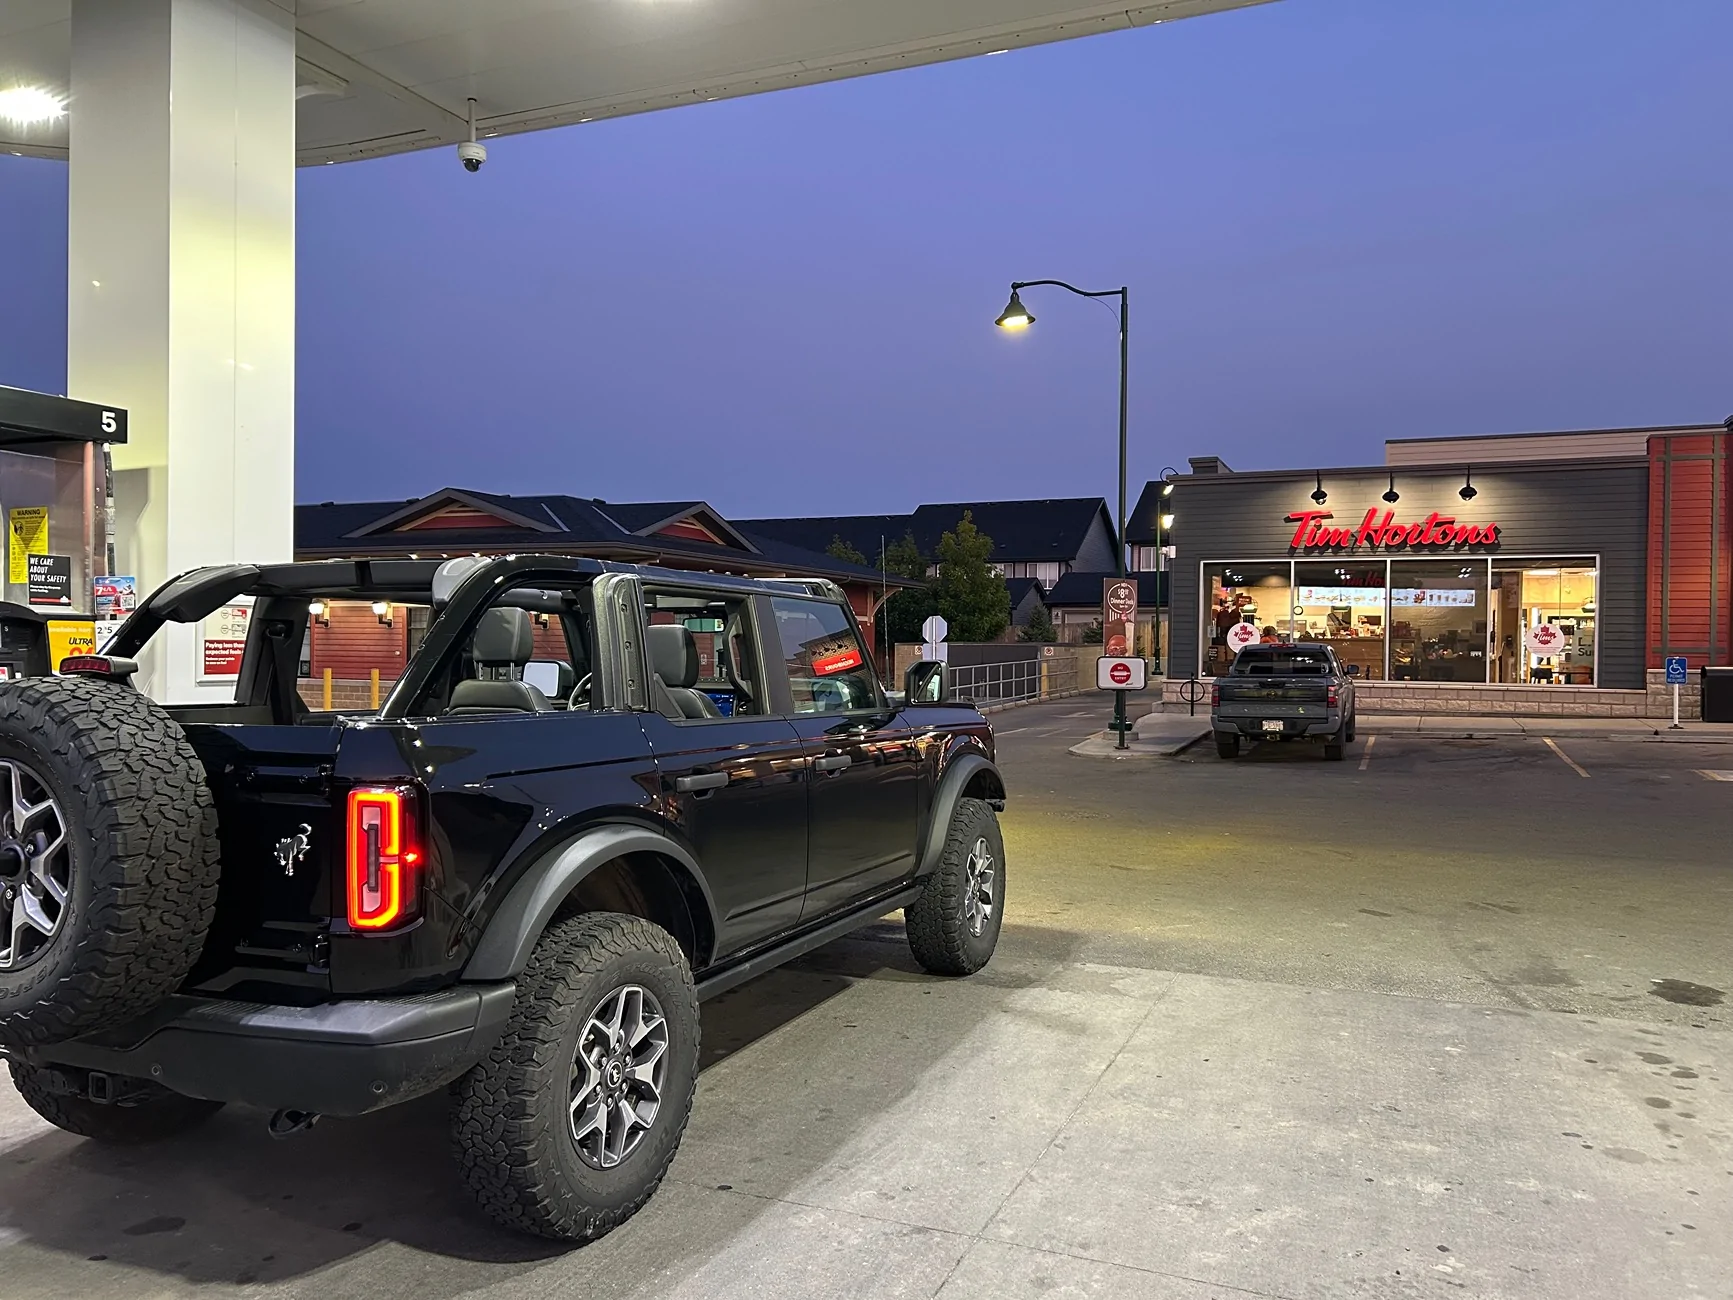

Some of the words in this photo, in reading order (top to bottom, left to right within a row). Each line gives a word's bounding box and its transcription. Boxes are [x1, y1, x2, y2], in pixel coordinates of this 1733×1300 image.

[101, 411, 117, 433] 5
[1288, 510, 1352, 547] Tim
[1356, 506, 1497, 546] Hortons
[30, 557, 38, 565] WE
[40, 558, 54, 566] CARE
[29, 566, 48, 574] ABOUT
[30, 574, 45, 582] YOUR
[46, 575, 67, 583] SAFETY
[68, 637, 93, 646] ULTRA
